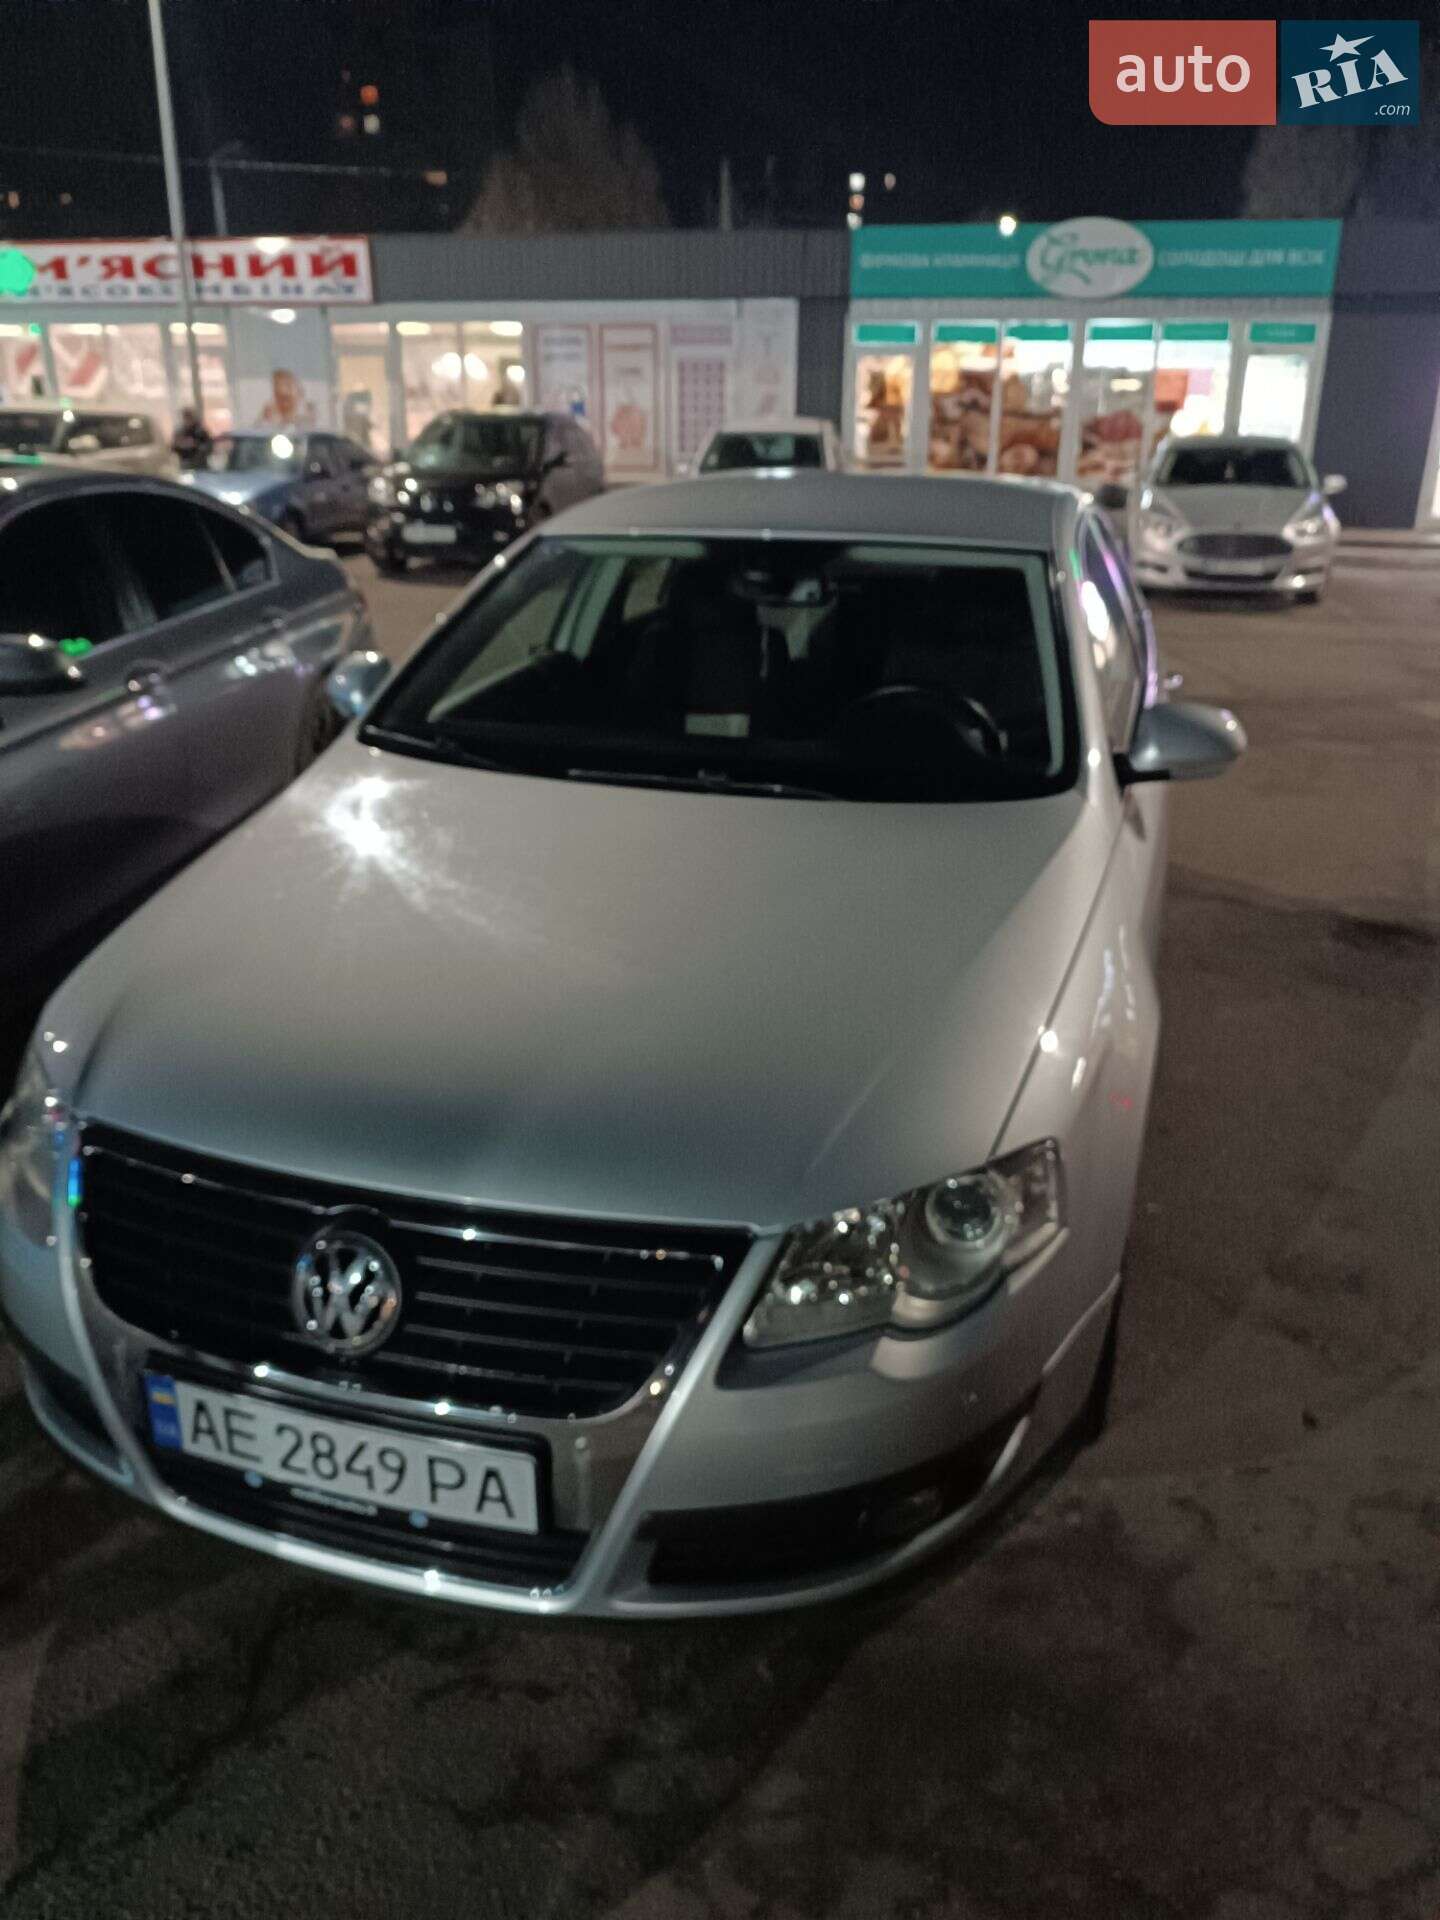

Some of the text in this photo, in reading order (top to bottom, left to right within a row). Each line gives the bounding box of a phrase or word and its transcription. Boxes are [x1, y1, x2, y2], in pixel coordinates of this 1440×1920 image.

[190, 1401, 262, 1463] AE
[274, 1423, 407, 1495] 2849
[427, 1455, 516, 1519] PA
